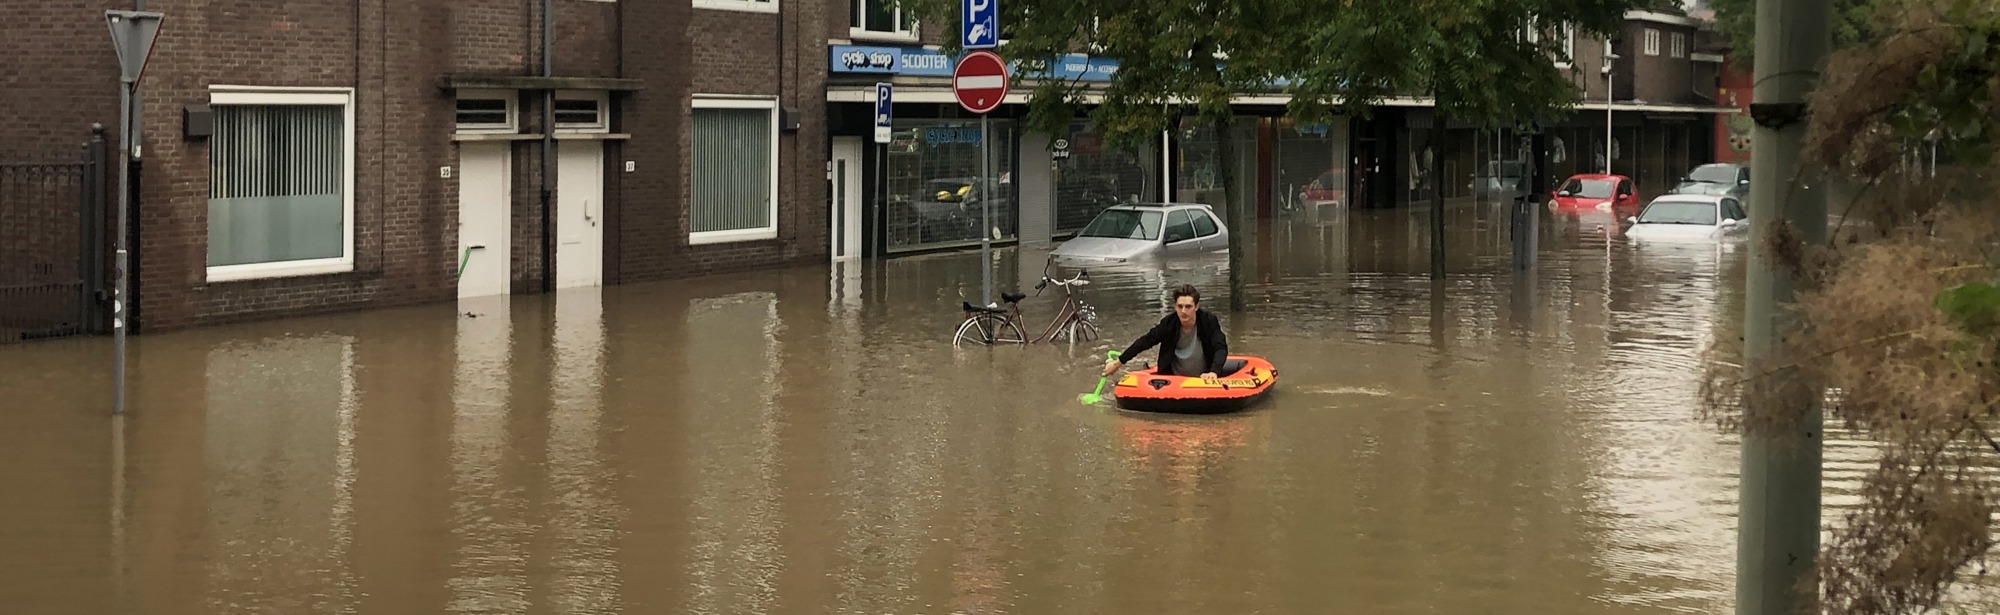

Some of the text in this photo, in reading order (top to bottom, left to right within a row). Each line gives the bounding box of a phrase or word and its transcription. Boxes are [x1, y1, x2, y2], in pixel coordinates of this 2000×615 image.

[970, 0, 989, 23] P
[841, 51, 948, 69] cycle shop SCOOTER
[880, 87, 889, 108] P
[925, 125, 956, 147] cycle
